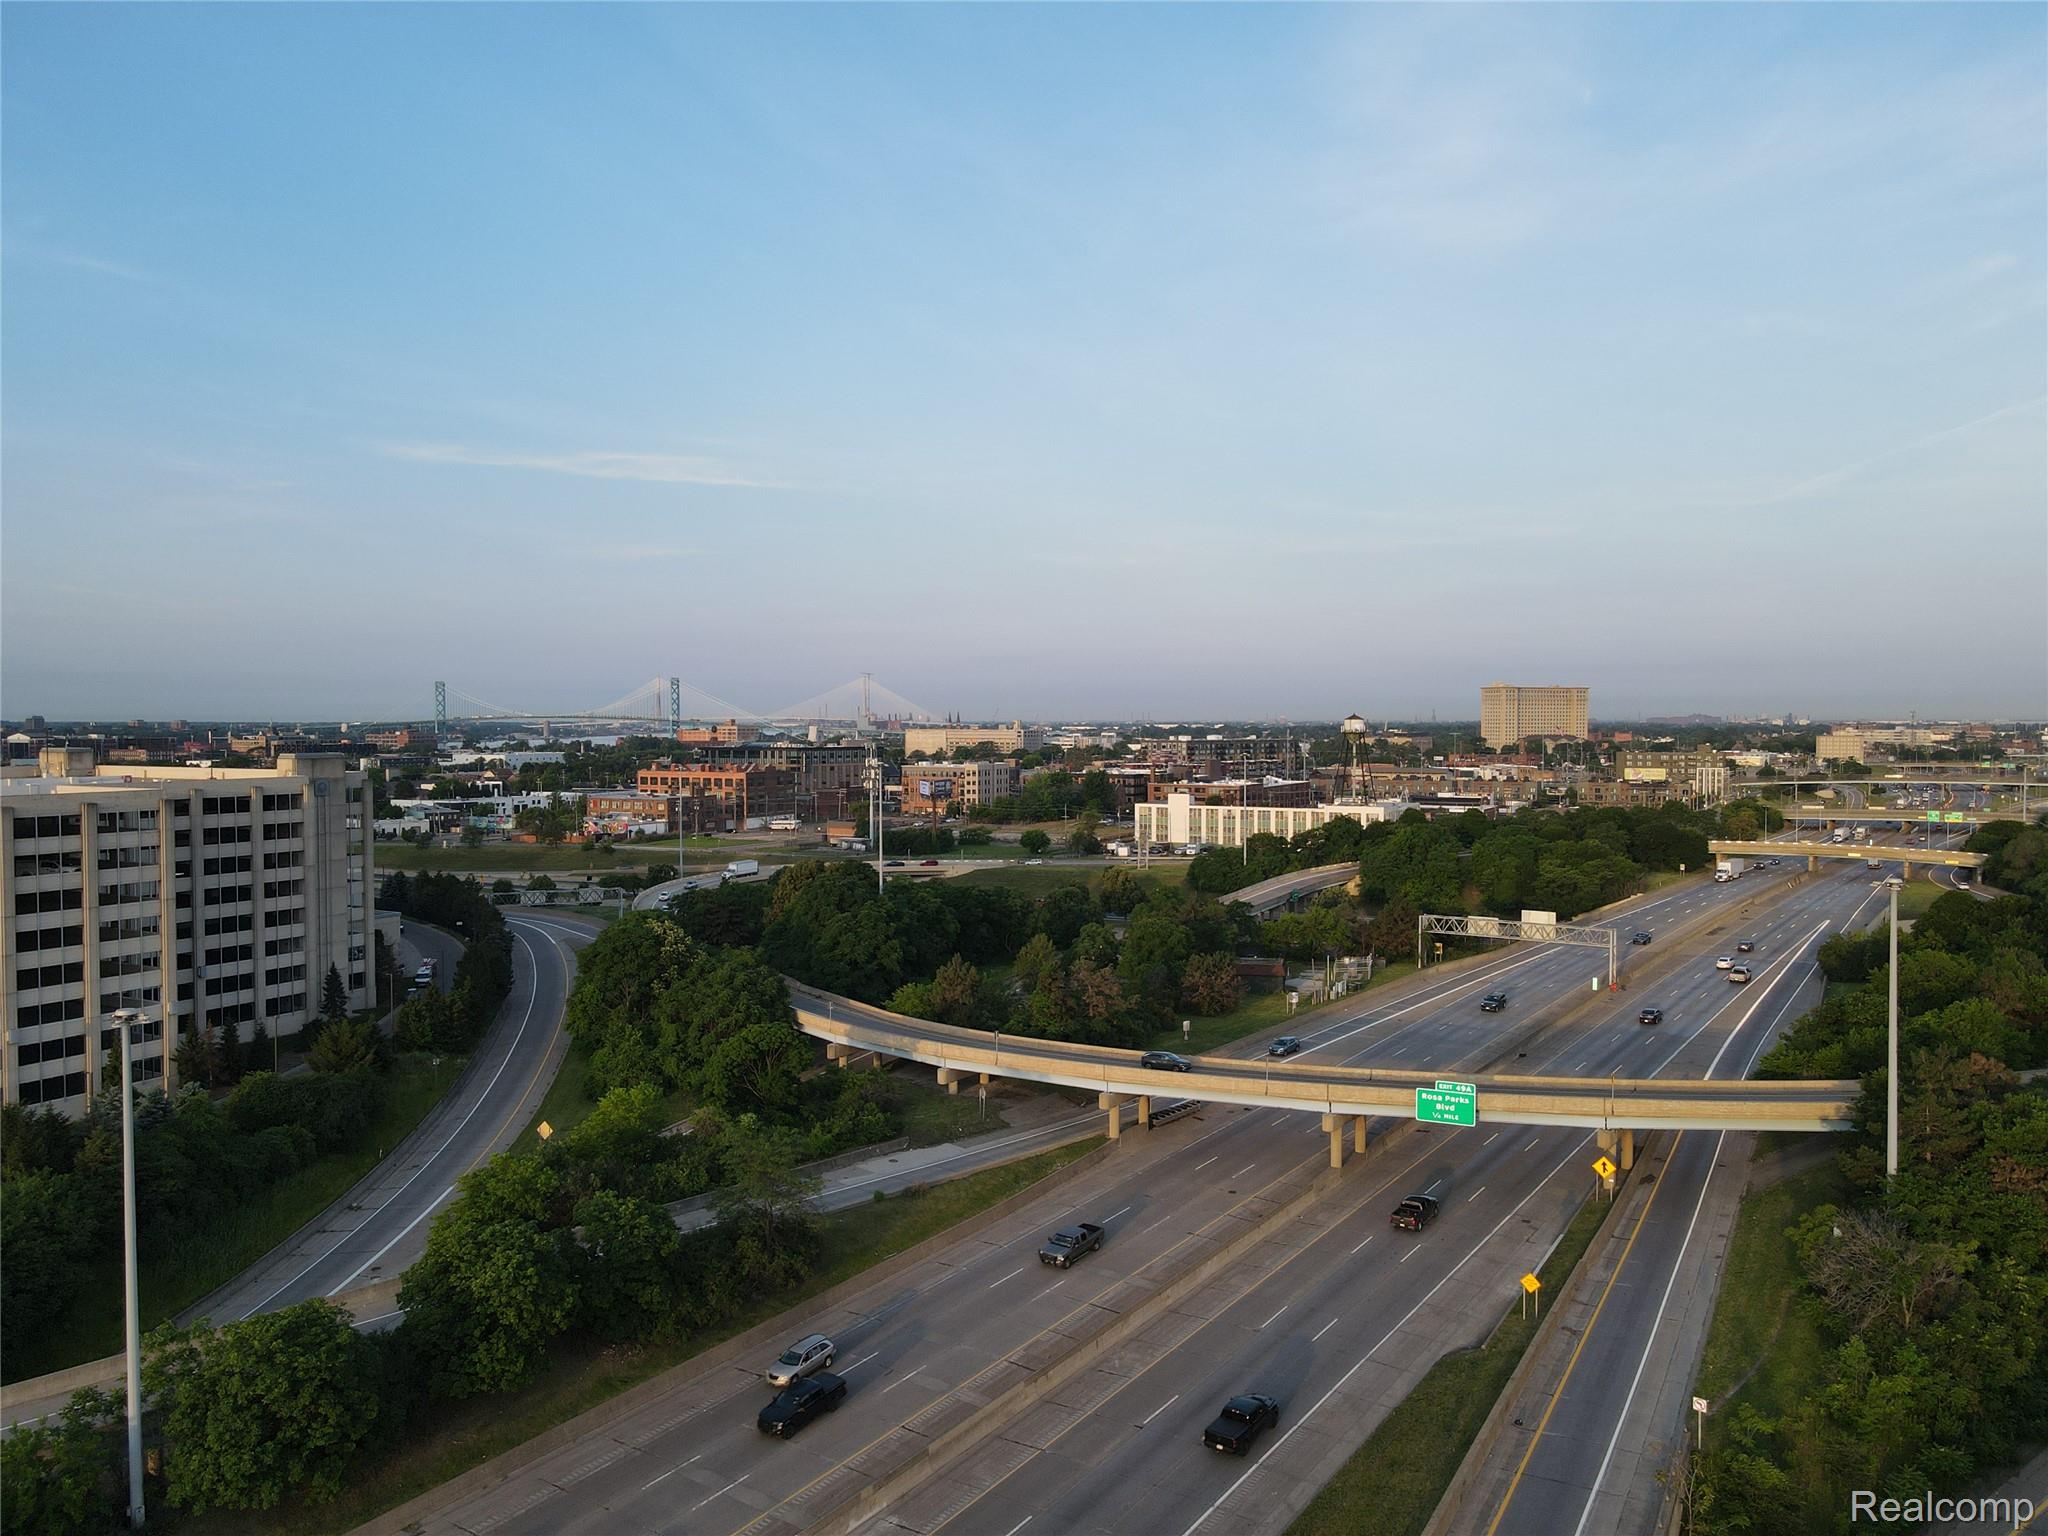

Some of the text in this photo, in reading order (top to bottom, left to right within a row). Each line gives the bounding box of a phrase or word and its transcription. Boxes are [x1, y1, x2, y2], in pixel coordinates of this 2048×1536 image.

[1455, 1085, 1472, 1093] 49A
[1421, 1093, 1470, 1104] Rosa Parks
[1435, 1103, 1455, 1111] Blvd
[1443, 1113, 1459, 1121] MILE
